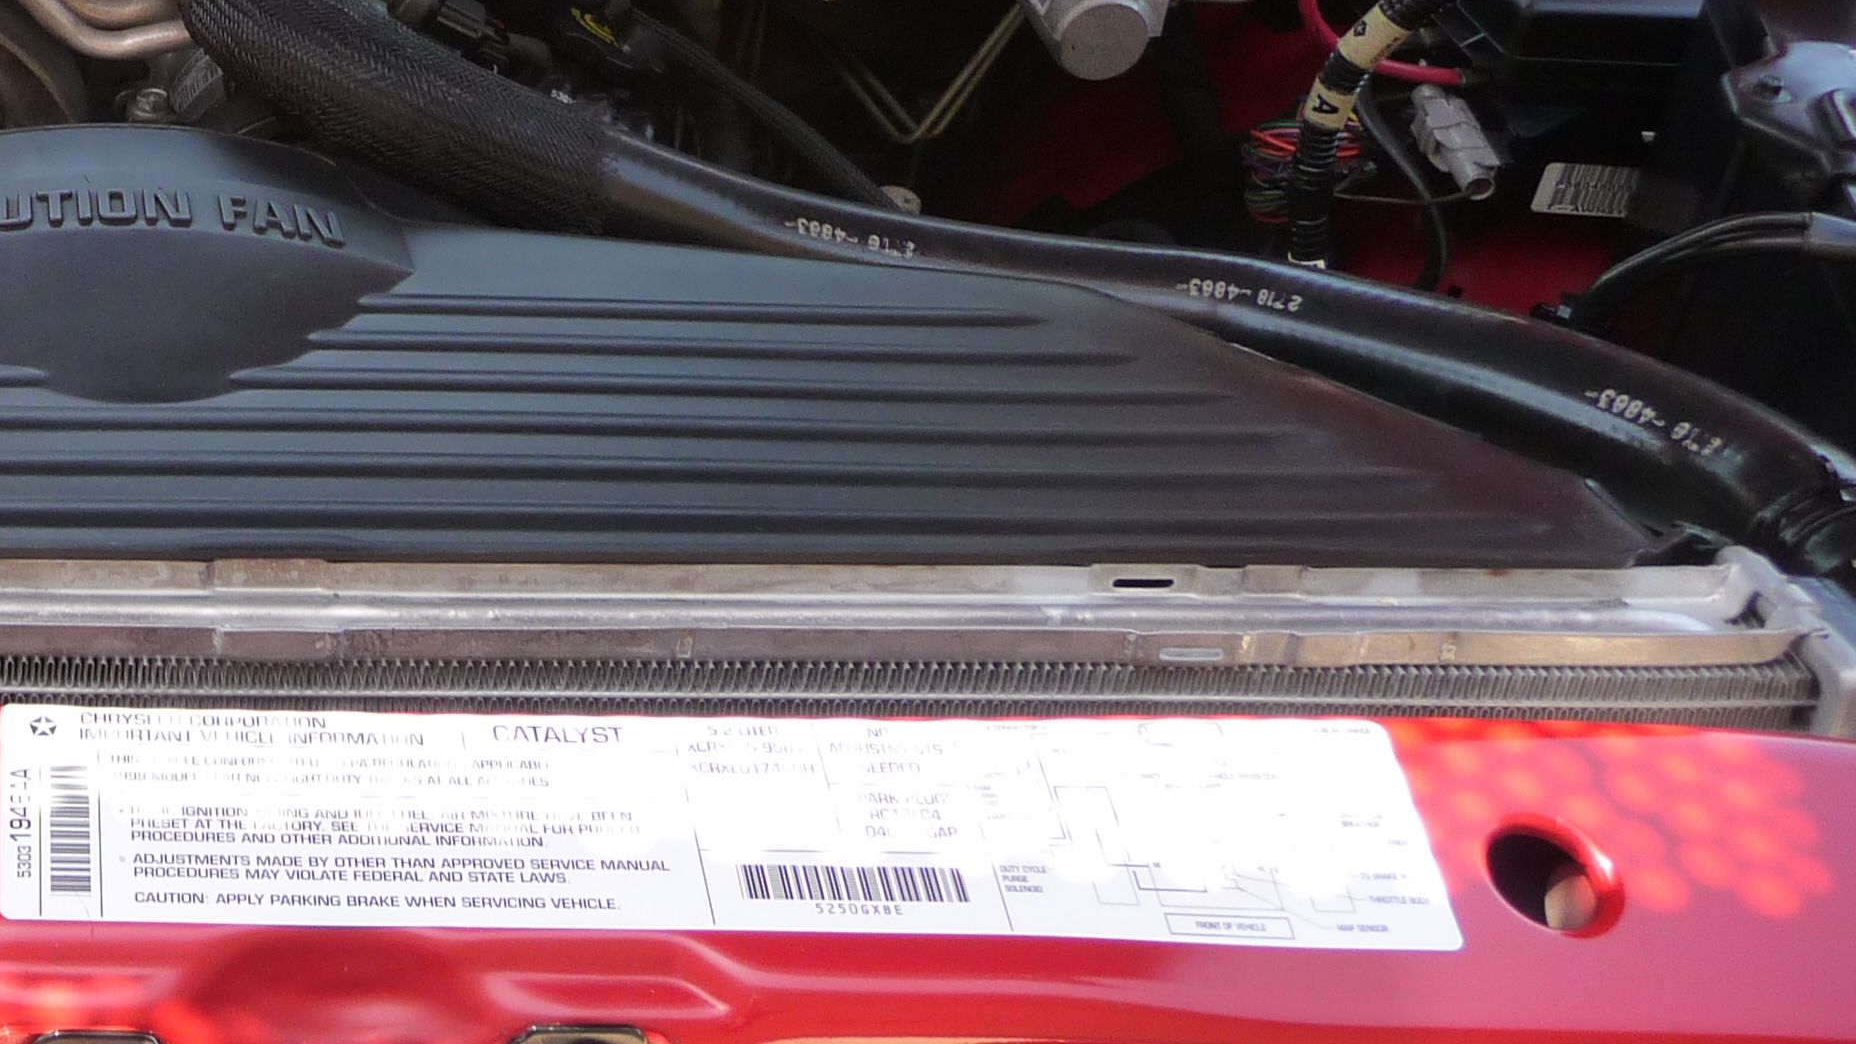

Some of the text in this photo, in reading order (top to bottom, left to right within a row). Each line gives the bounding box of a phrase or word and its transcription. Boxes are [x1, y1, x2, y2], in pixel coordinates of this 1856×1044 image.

[216, 193, 347, 249] FAN
[492, 724, 623, 744] CATALYST
[181, 805, 249, 817] IGNITION
[194, 818, 213, 830] AT
[217, 818, 247, 830] THE
[330, 820, 359, 832] SEE
[130, 829, 236, 844] PROCEDURES
[241, 831, 276, 845] AND
[280, 832, 333, 846] OTHER
[337, 833, 431, 848] ADDITIONAL
[132, 852, 672, 873] ADJUSTMENTS MADE BY OTHER THAN APPROVED SERVICE MANUAL
[133, 866, 572, 885] PROCEDURES MAY VIOLATE FEDERAL AND STATE LAWS.
[133, 891, 622, 912] CAUTION: APPLY PARKING BRAKE WHEN SERVICING VEHICLE.
[1195, 920, 1221, 930] FRONT
[1234, 921, 1266, 932] VEHICLE
